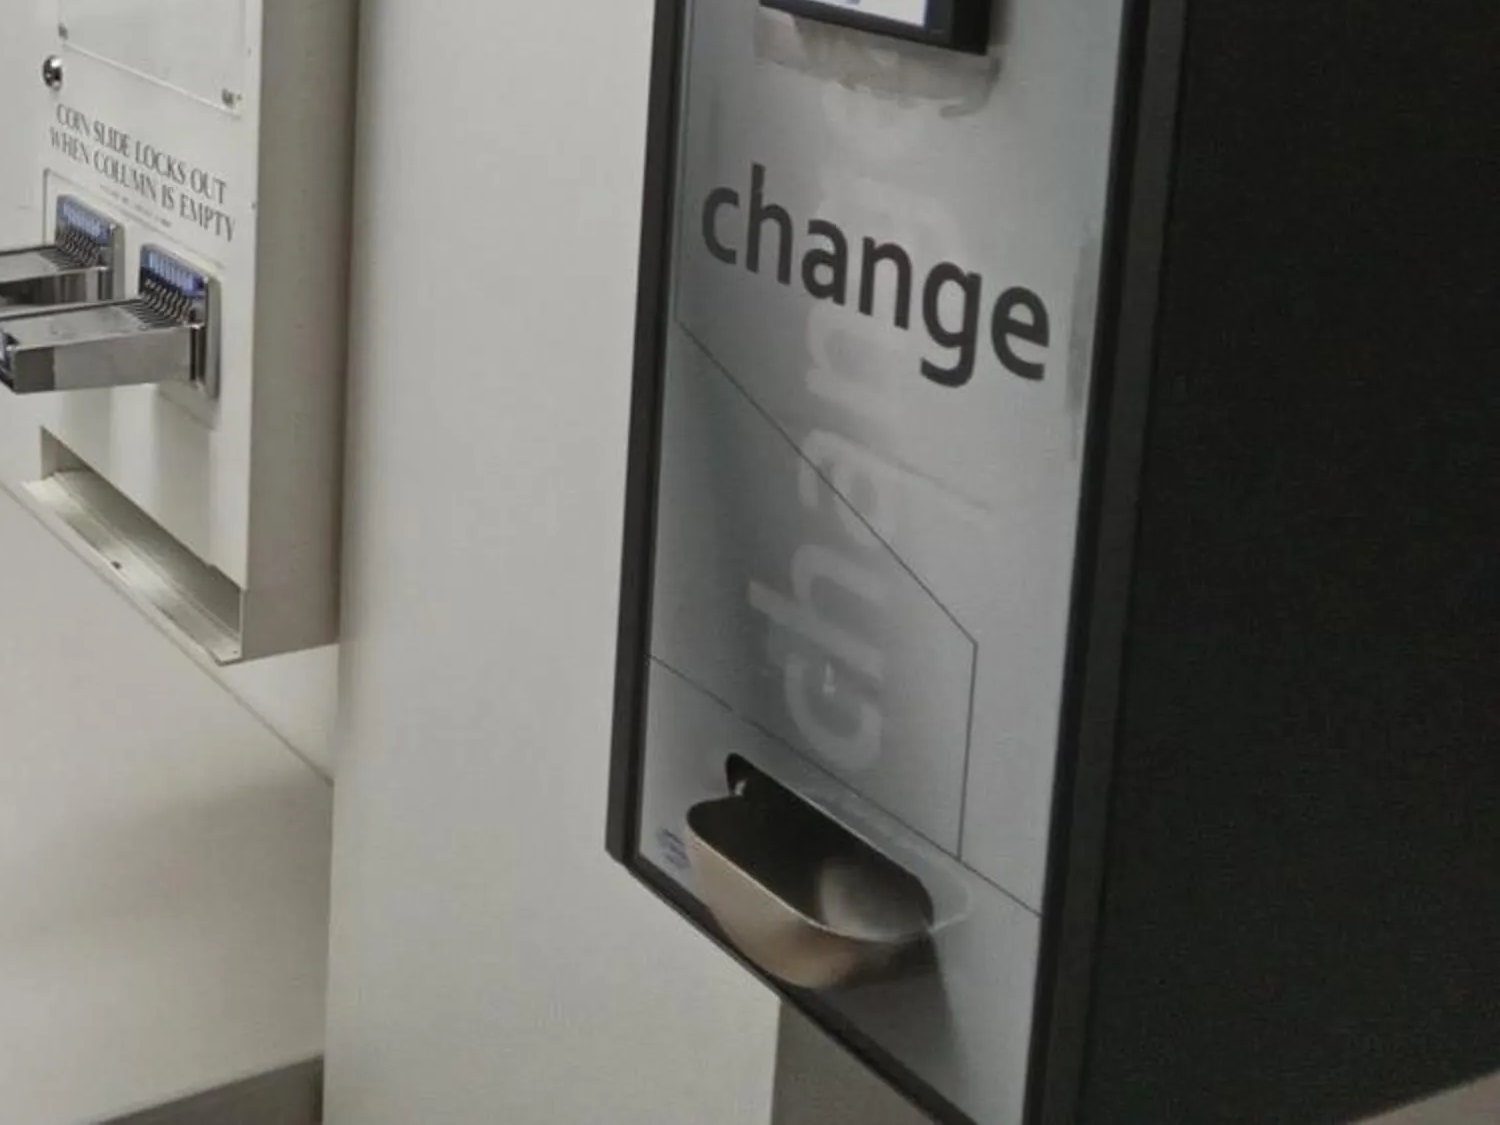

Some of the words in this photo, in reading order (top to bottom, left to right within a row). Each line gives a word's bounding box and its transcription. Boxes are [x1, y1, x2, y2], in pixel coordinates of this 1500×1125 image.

[50, 126, 91, 165] WHEN
[93, 149, 156, 202] COLUMN
[161, 184, 175, 211] IS
[179, 192, 236, 243] EMPTY
[56, 103, 91, 138] COIN
[92, 120, 131, 158] SLIDE
[134, 140, 187, 186] LOCKS
[190, 168, 227, 205] OUT
[701, 163, 1051, 389] change
